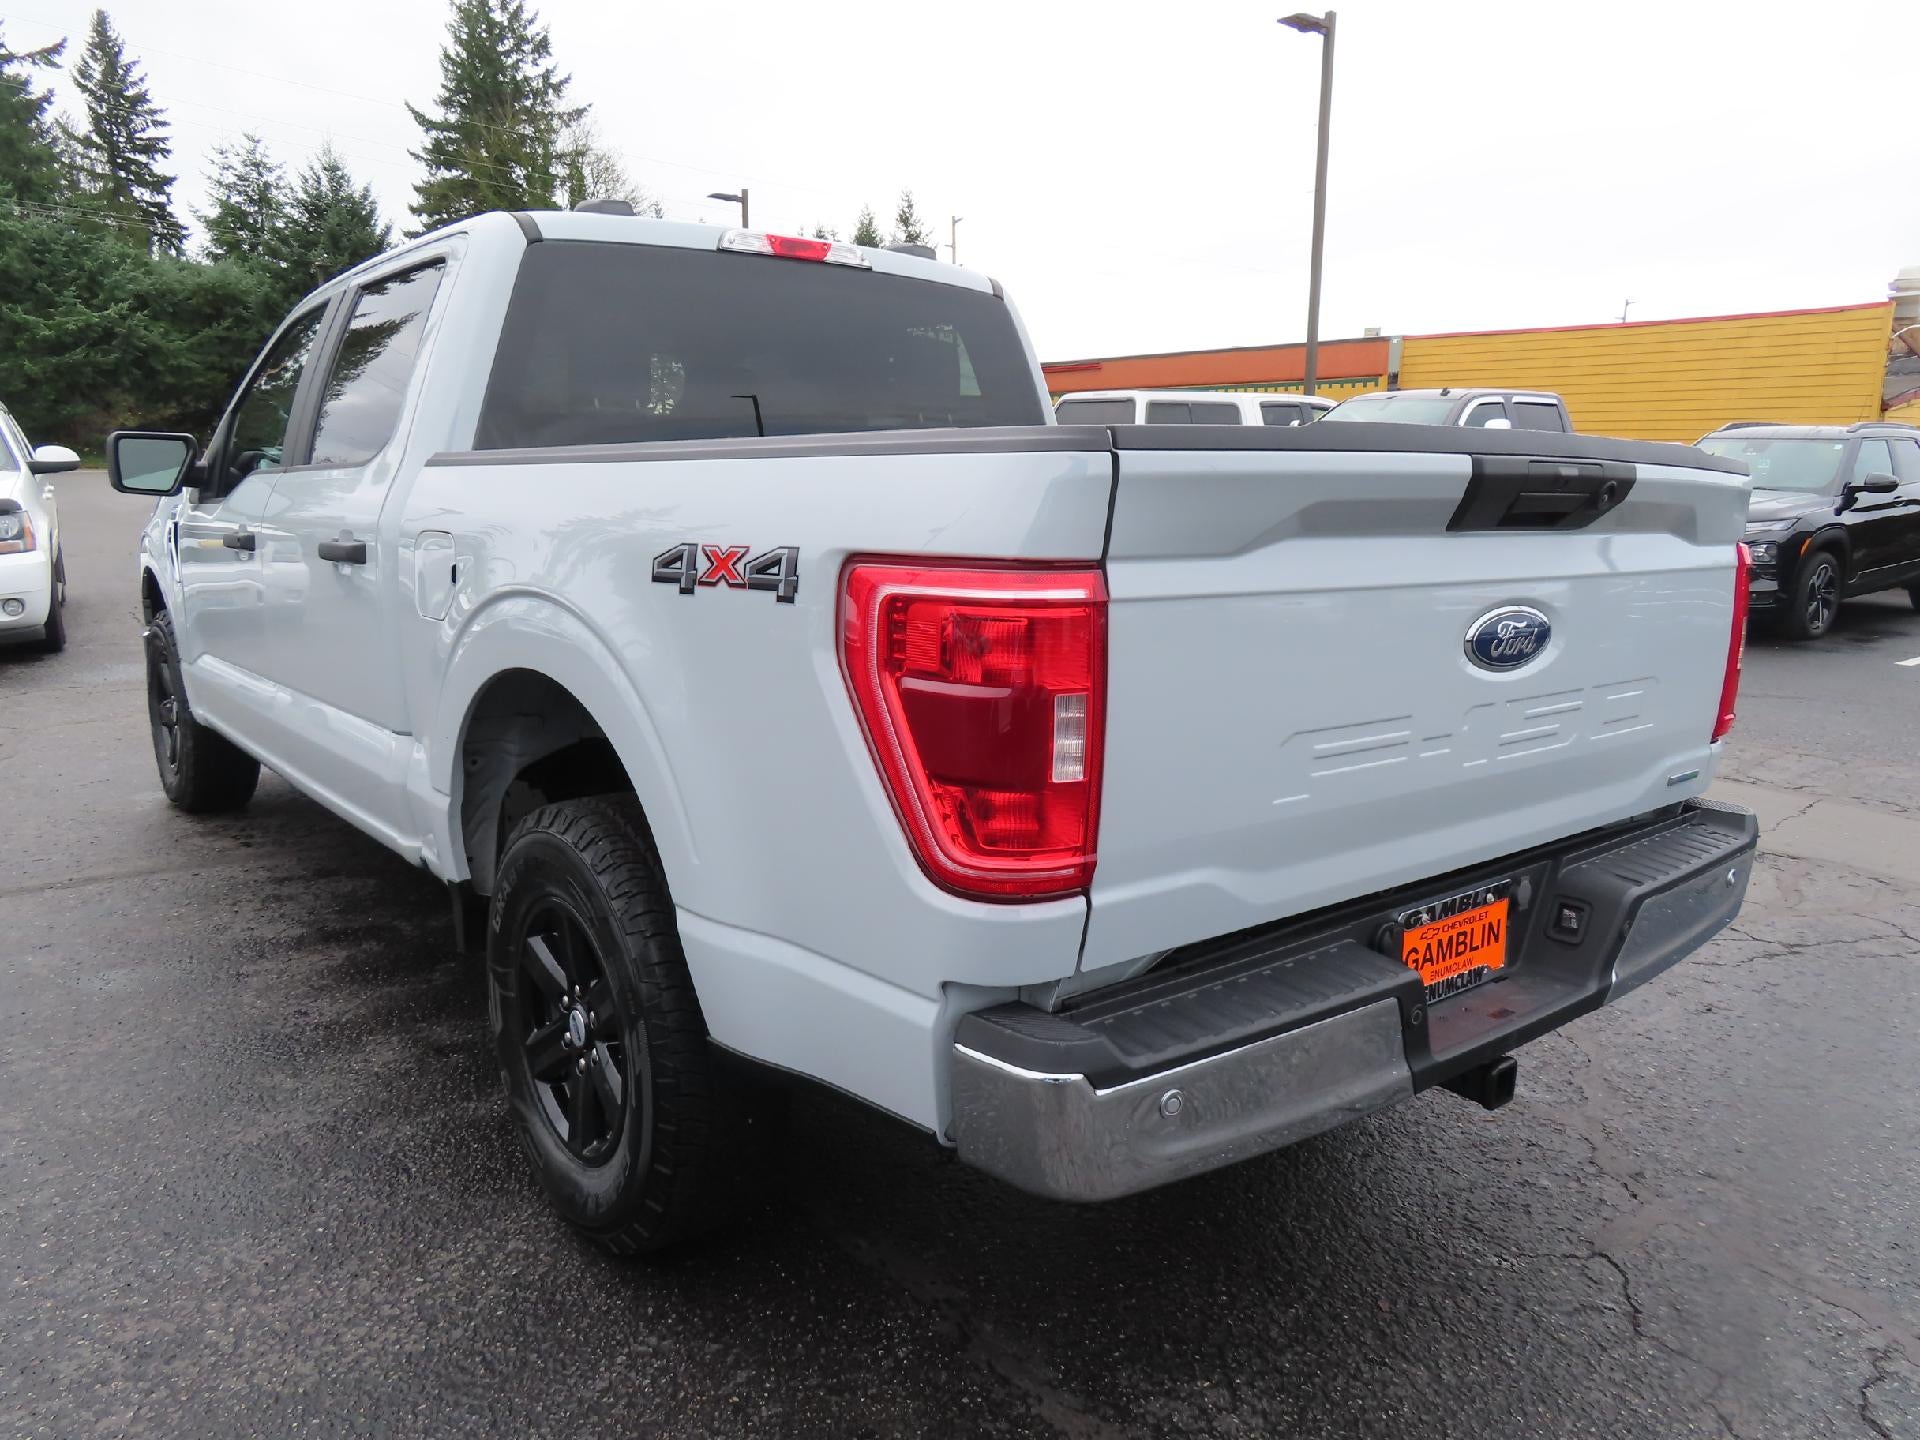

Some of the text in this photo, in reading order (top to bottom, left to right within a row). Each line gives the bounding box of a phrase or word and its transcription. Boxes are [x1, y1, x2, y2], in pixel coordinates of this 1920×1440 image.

[651, 542, 800, 604] 4X4
[1490, 620, 1538, 658] Ford
[1403, 882, 1509, 930] GAMBL
[1441, 911, 1489, 933] CHEVROLET
[1405, 919, 1501, 972] GAMBLIN
[1430, 956, 1473, 981] ENUMCLAW
